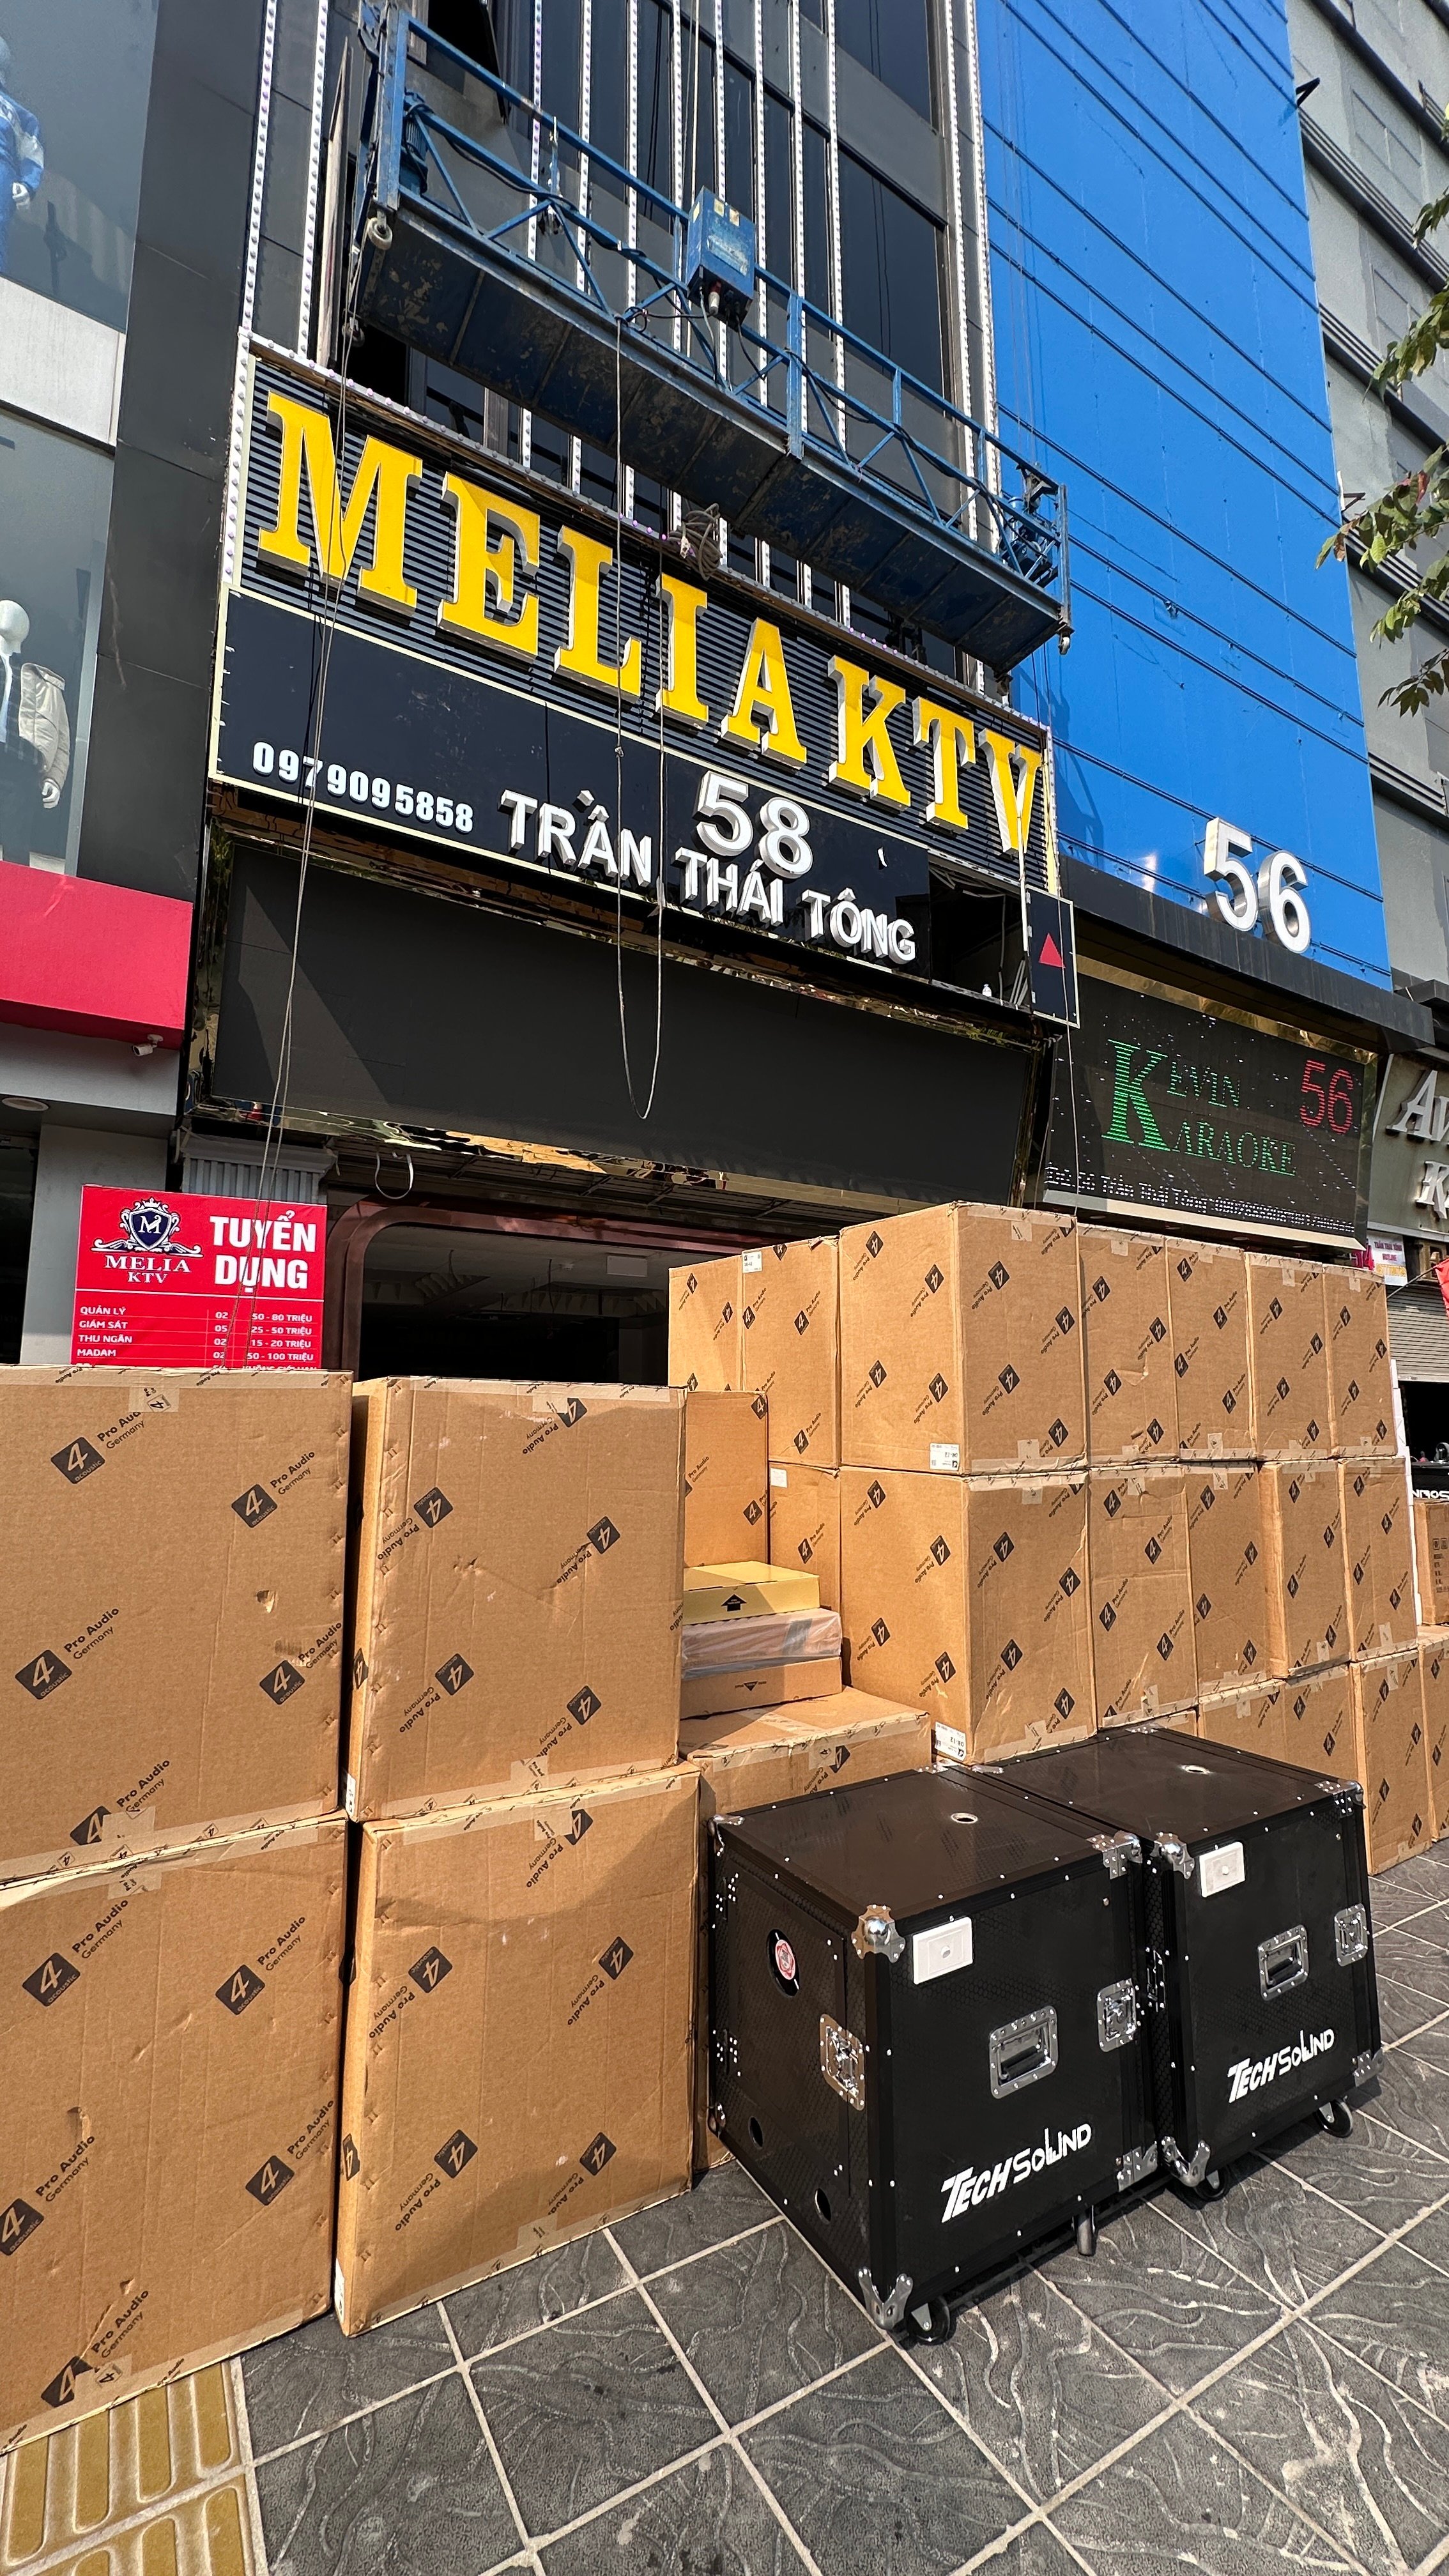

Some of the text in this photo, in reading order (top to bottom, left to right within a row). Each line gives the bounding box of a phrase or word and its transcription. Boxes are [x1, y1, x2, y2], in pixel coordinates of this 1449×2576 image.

[257, 390, 1042, 857] MELIA KTV
[252, 741, 474, 832] 0979095858
[693, 770, 815, 879] 58
[498, 789, 916, 965] TRẦN THÁI TÔNG
[1204, 816, 1312, 954] 56
[1300, 1059, 1353, 1135] 56
[210, 1210, 316, 1252] TUYỂN
[104, 1254, 191, 1273] MELIA
[128, 1272, 168, 1284] KTV
[215, 1255, 308, 1292] DỤNG
[77, 1349, 116, 1357] MADAM
[79, 1334, 100, 1342] THU
[97, 1427, 118, 1443] Pro
[107, 1419, 145, 1448] Germany
[523, 1423, 558, 1454] Pro Audio
[270, 1451, 316, 1489] Pro Audio
[278, 1467, 311, 1495] Germany
[378, 1524, 420, 1560] Pro Audio
[382, 1517, 413, 1544] Germany
[578, 1551, 592, 1563] Pro
[64, 1607, 119, 1653] Pro Audio
[74, 1626, 114, 1660] Germany
[298, 1622, 342, 1662] Pro Audio
[305, 1639, 338, 1669] Germany
[399, 1693, 441, 1733] Pro Audio
[404, 1687, 434, 1716] Germany
[539, 1717, 566, 1745] Germany
[558, 1722, 572, 1737] Pro
[116, 1760, 170, 1807] Pro Audio
[526, 1844, 564, 1887] Pro Audio
[529, 1838, 556, 1869] Germany
[72, 1899, 128, 1954] Pro Audio
[82, 1919, 123, 1959] Germany
[257, 1917, 305, 1965] Pro Audio
[266, 1935, 301, 1971] Germany
[374, 1986, 408, 2020] Germany
[567, 1980, 604, 2025] Pro Audio
[571, 1975, 598, 2007] Germany
[369, 1991, 415, 2038] Pro Audio
[288, 2099, 335, 2156] Pro Audio
[296, 2119, 330, 2159] Germany
[35, 2135, 95, 2197] Pro Audio
[45, 2157, 89, 2202] Germany
[569, 2177, 585, 2193] Pro
[395, 2179, 441, 2231] Pro Audio
[399, 2173, 433, 2211] Germany
[549, 2173, 578, 2206] Germany
[90, 2290, 149, 2355] Pro Audio
[101, 2312, 144, 2358] Germany
